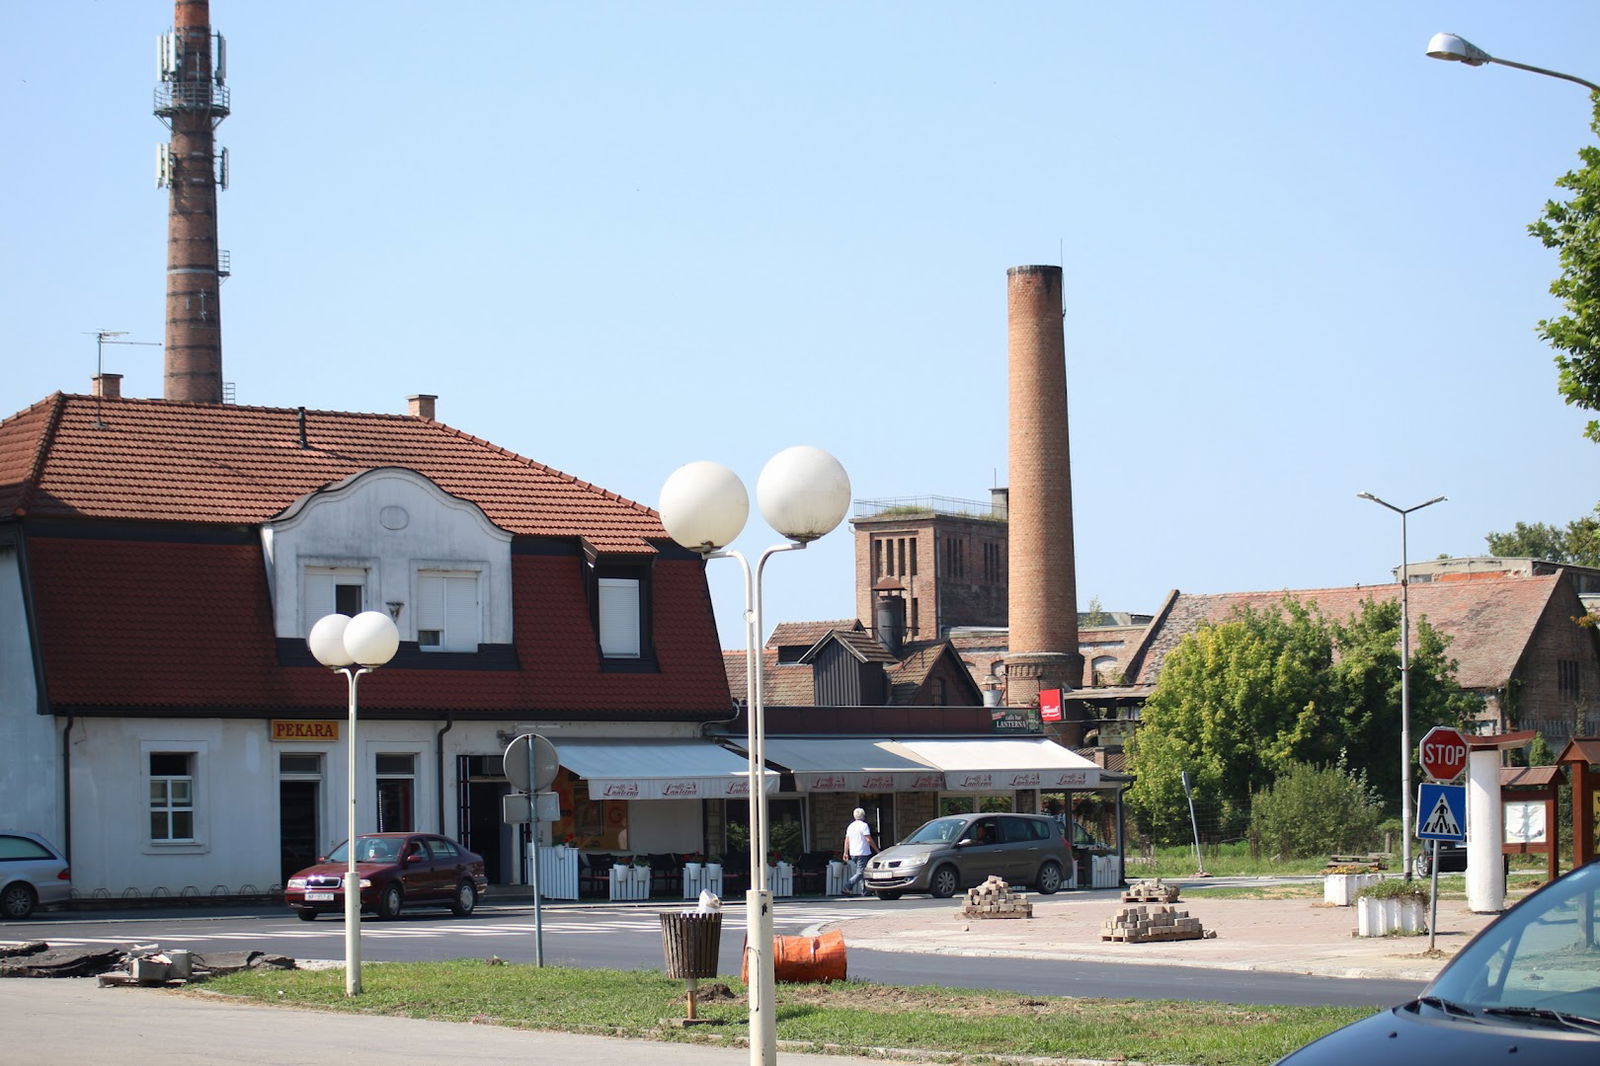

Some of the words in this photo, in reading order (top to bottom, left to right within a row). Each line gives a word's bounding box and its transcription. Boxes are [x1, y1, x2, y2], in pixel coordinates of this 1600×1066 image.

[276, 723, 334, 737] PEKARA
[996, 720, 1026, 728] LANTERNA
[1425, 744, 1465, 766] STOP
[603, 783, 639, 797] Lanterna
[663, 783, 697, 796] Lanterna
